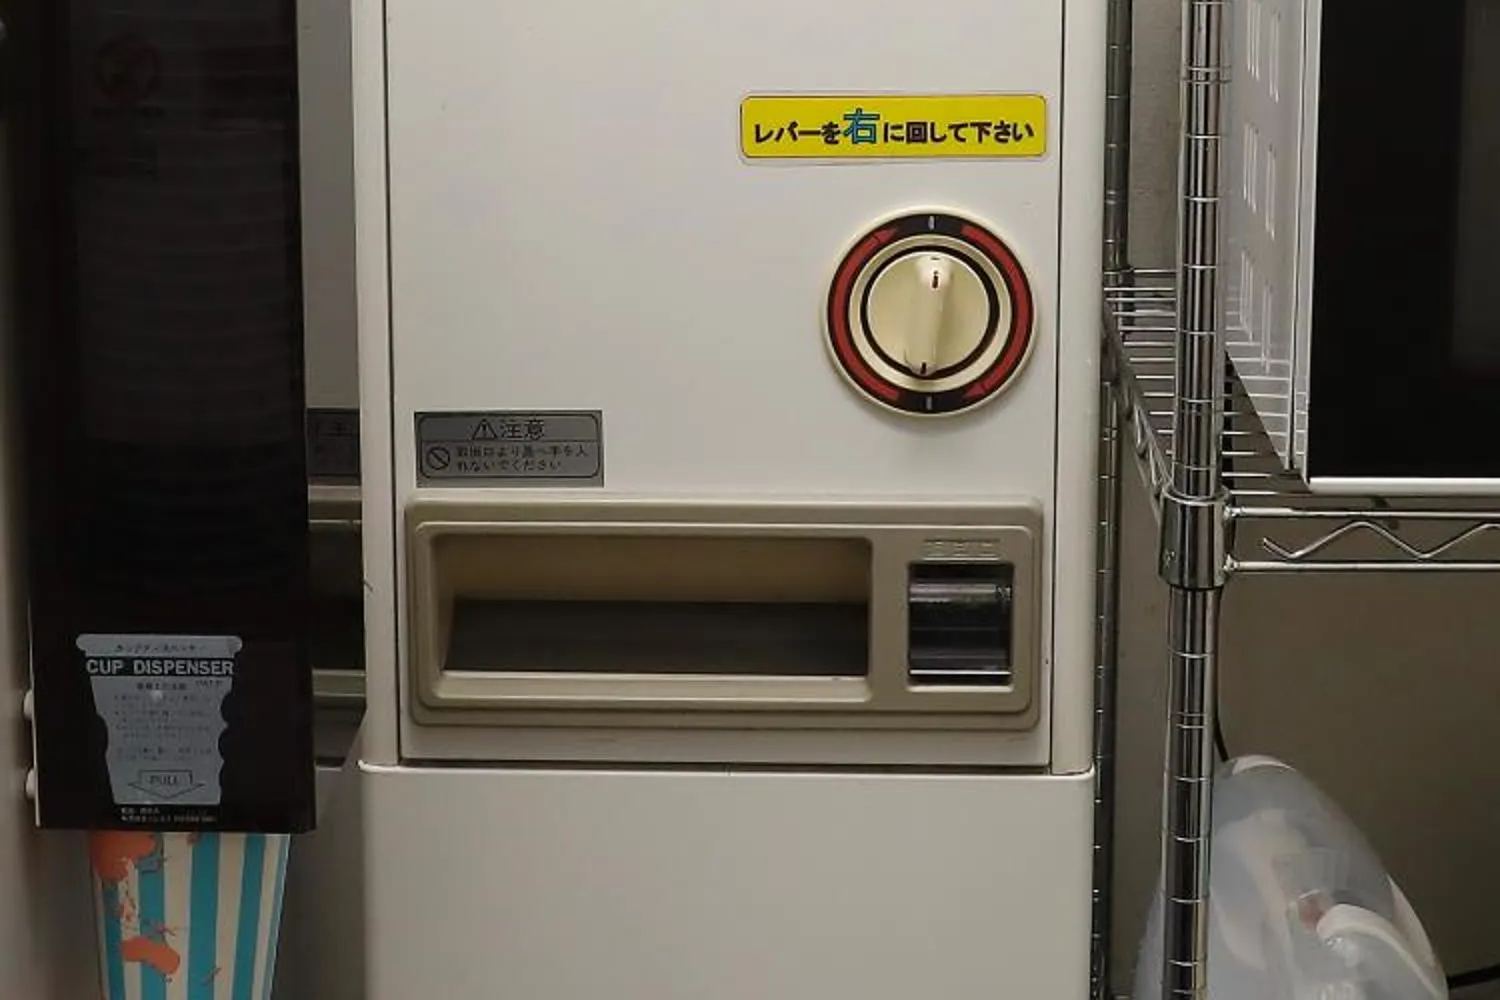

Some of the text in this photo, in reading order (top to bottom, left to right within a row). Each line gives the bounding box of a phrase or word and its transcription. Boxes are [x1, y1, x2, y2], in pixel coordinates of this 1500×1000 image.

[755, 108, 1035, 144] レバーを右に回して下さい
[501, 418, 545, 441] 注意
[86, 659, 234, 676] CUP DISPENSER
